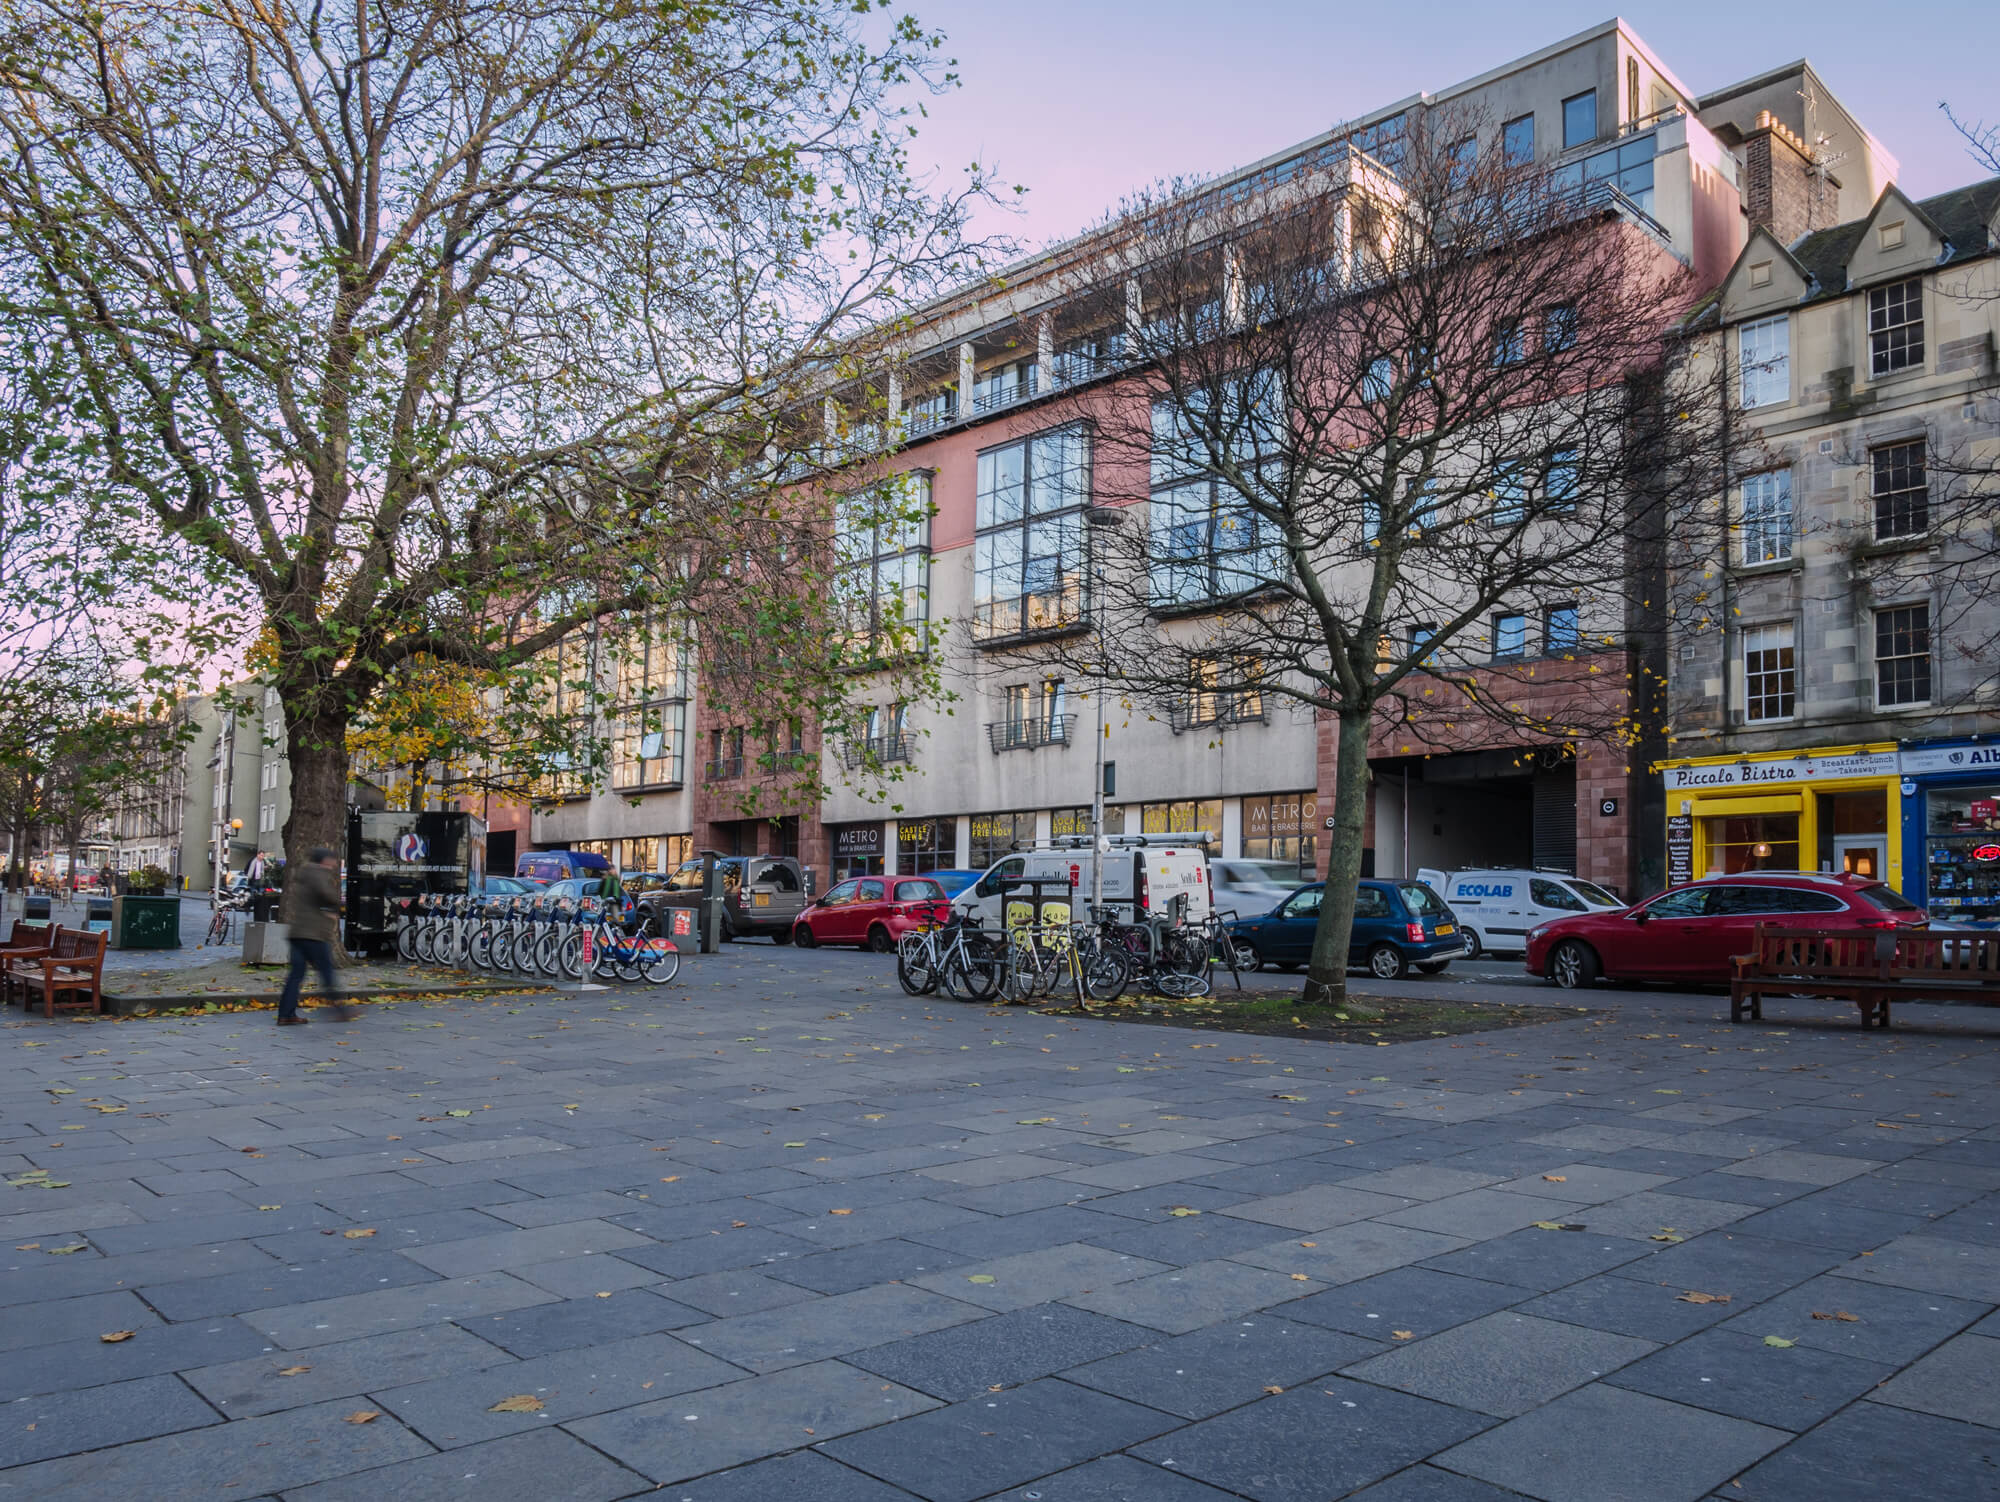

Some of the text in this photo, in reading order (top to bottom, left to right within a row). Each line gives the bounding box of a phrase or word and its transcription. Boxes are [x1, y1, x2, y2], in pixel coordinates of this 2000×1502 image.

[1676, 765, 1796, 786] Piccolo Bistro
[1252, 802, 1316, 821] METRO
[1053, 815, 1081, 825] LOCAL
[899, 825, 927, 834] CASTLE
[972, 821, 1001, 830] FAMILY
[1052, 824, 1087, 834] DISHES
[1251, 824, 1266, 832] BAR
[839, 830, 878, 843] METRO
[899, 832, 922, 841] VIEWS
[972, 828, 1012, 837] FRIENDLY
[1457, 884, 1513, 897] ECOLAB
